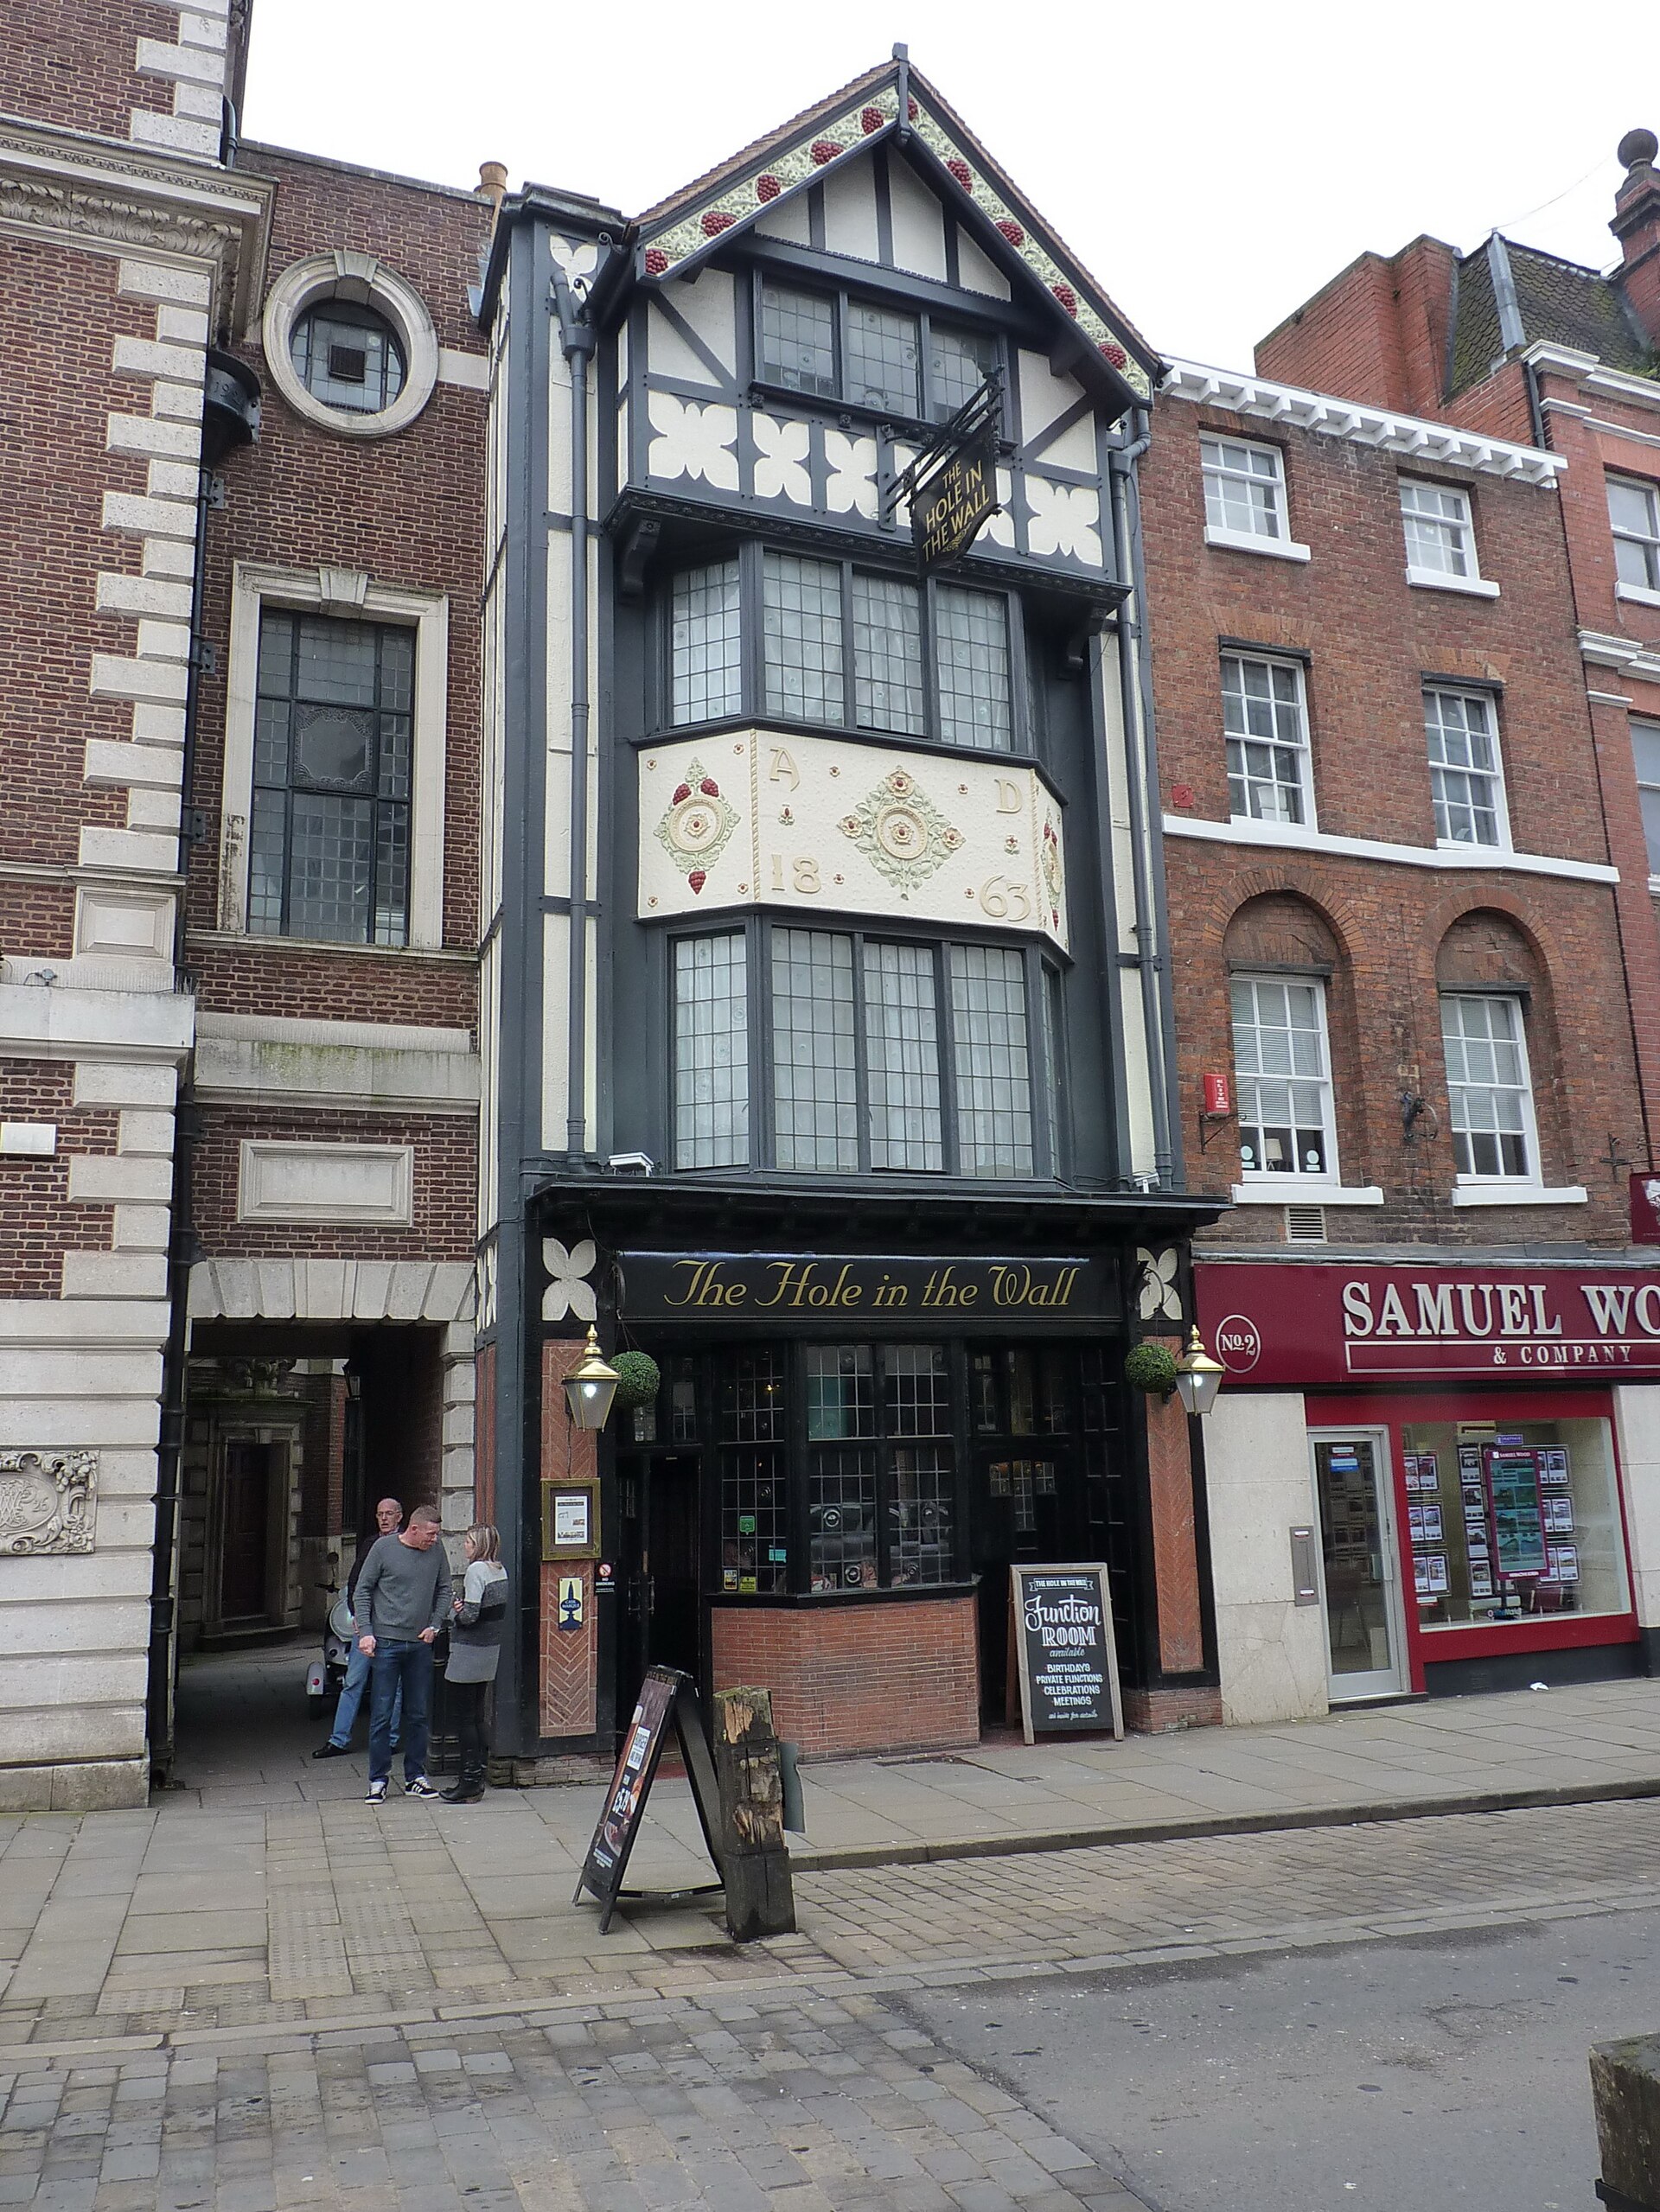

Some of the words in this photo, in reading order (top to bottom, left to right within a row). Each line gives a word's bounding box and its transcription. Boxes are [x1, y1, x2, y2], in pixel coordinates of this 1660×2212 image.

[942, 461, 961, 488] THE
[925, 481, 963, 533] HOLE
[965, 460, 983, 494] IN
[923, 522, 949, 562] THE
[951, 484, 990, 534] WALL
[769, 748, 801, 792] A
[994, 779, 1023, 813] D
[770, 853, 821, 894] 18
[979, 874, 1031, 921] 63
[664, 1259, 747, 1306] The
[755, 1261, 863, 1307] Hole
[872, 1274, 908, 1306] in
[921, 1265, 978, 1306] the
[988, 1265, 1080, 1306] Wall
[1343, 1281, 1563, 1337] SAMUEL
[1493, 1347, 1508, 1365] &
[1521, 1345, 1631, 1363] COMPANY
[1025, 1594, 1102, 1632] Function
[1041, 1626, 1097, 1647] ROOM
[1049, 1647, 1086, 1657] available
[1036, 1674, 1064, 1685] PRIVATE
[1064, 1673, 1103, 1684] FUNCTIONS
[1046, 1663, 1091, 1673] BIRTHDAYS
[1044, 1685, 1101, 1696] CELEBRATIONS
[1053, 1696, 1093, 1706] MEETINGS
